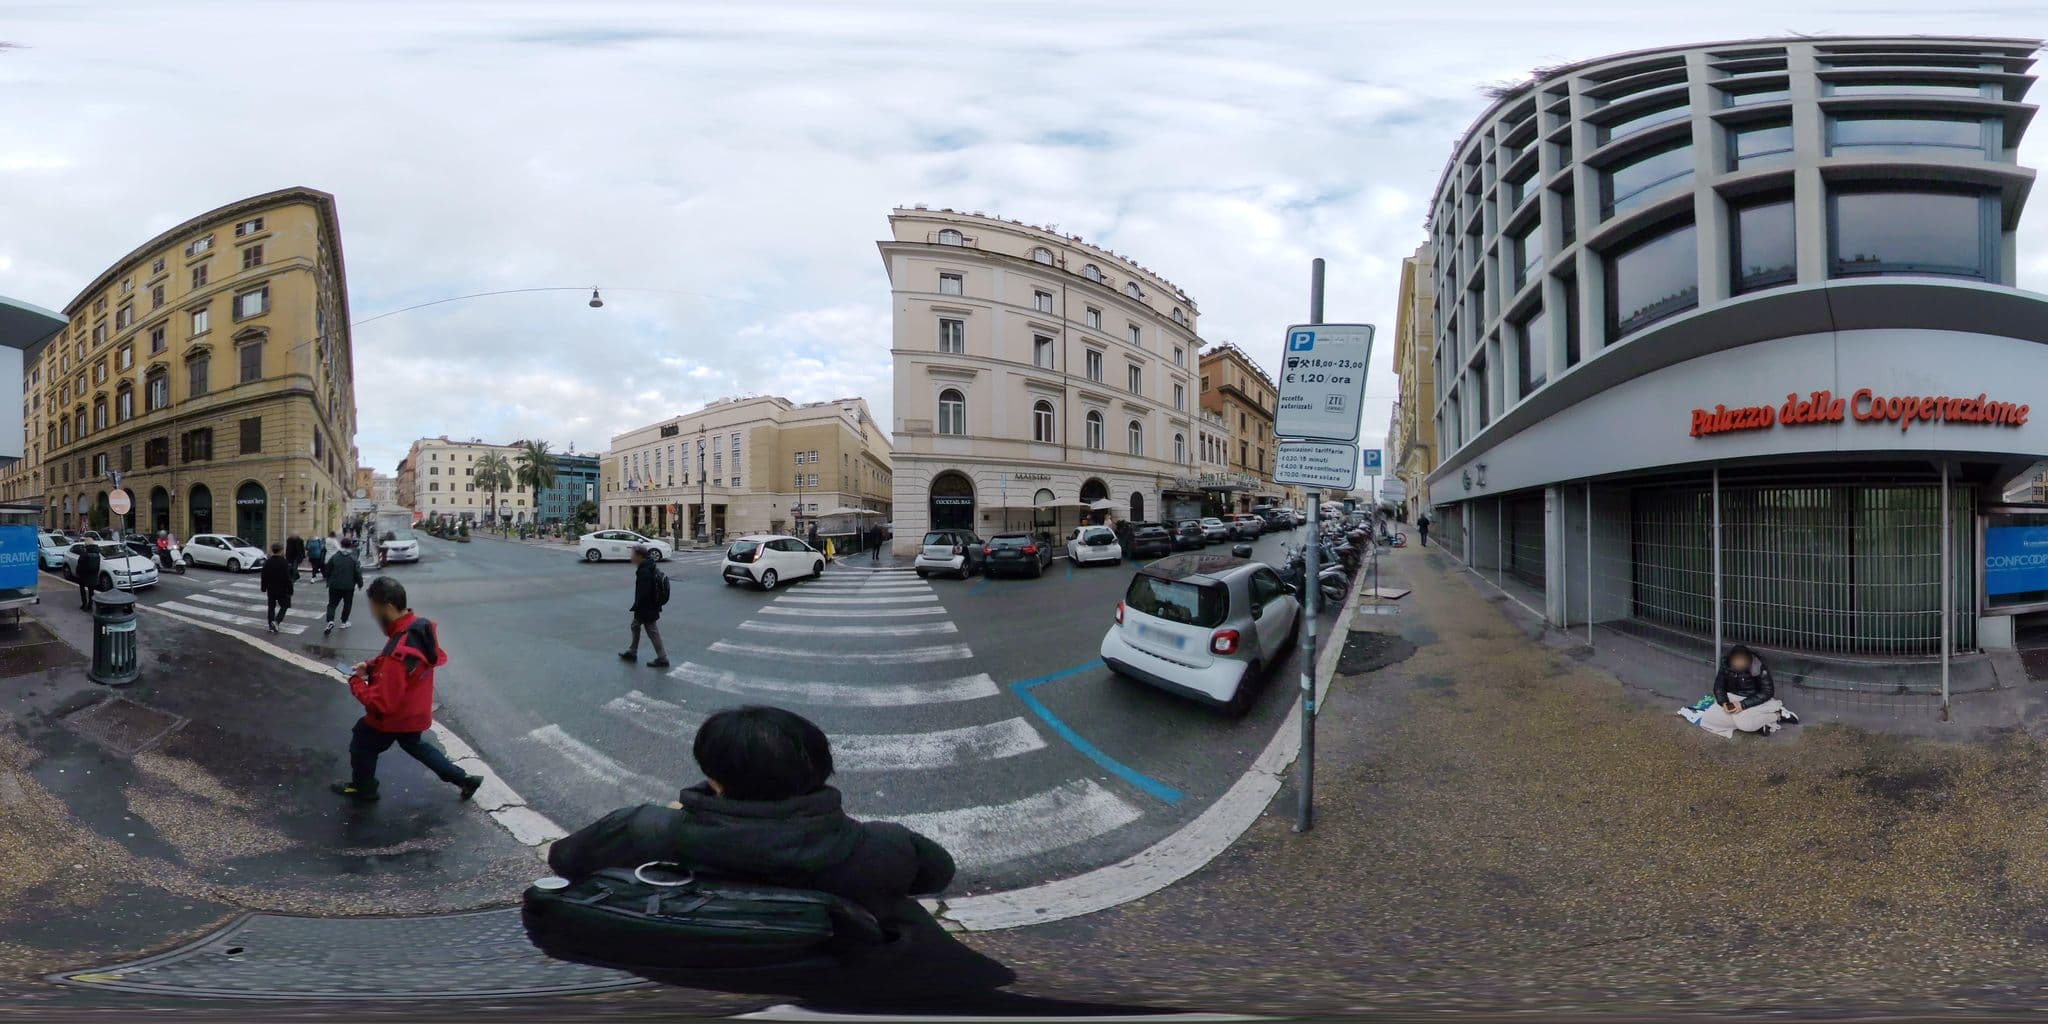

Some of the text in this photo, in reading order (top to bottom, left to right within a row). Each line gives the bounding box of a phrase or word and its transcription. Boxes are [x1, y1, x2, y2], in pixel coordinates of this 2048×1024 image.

[1286, 374, 1296, 384] €
[1280, 402, 1313, 410] autorizzati
[1690, 388, 2031, 437] Palazzo della Cooperazione
